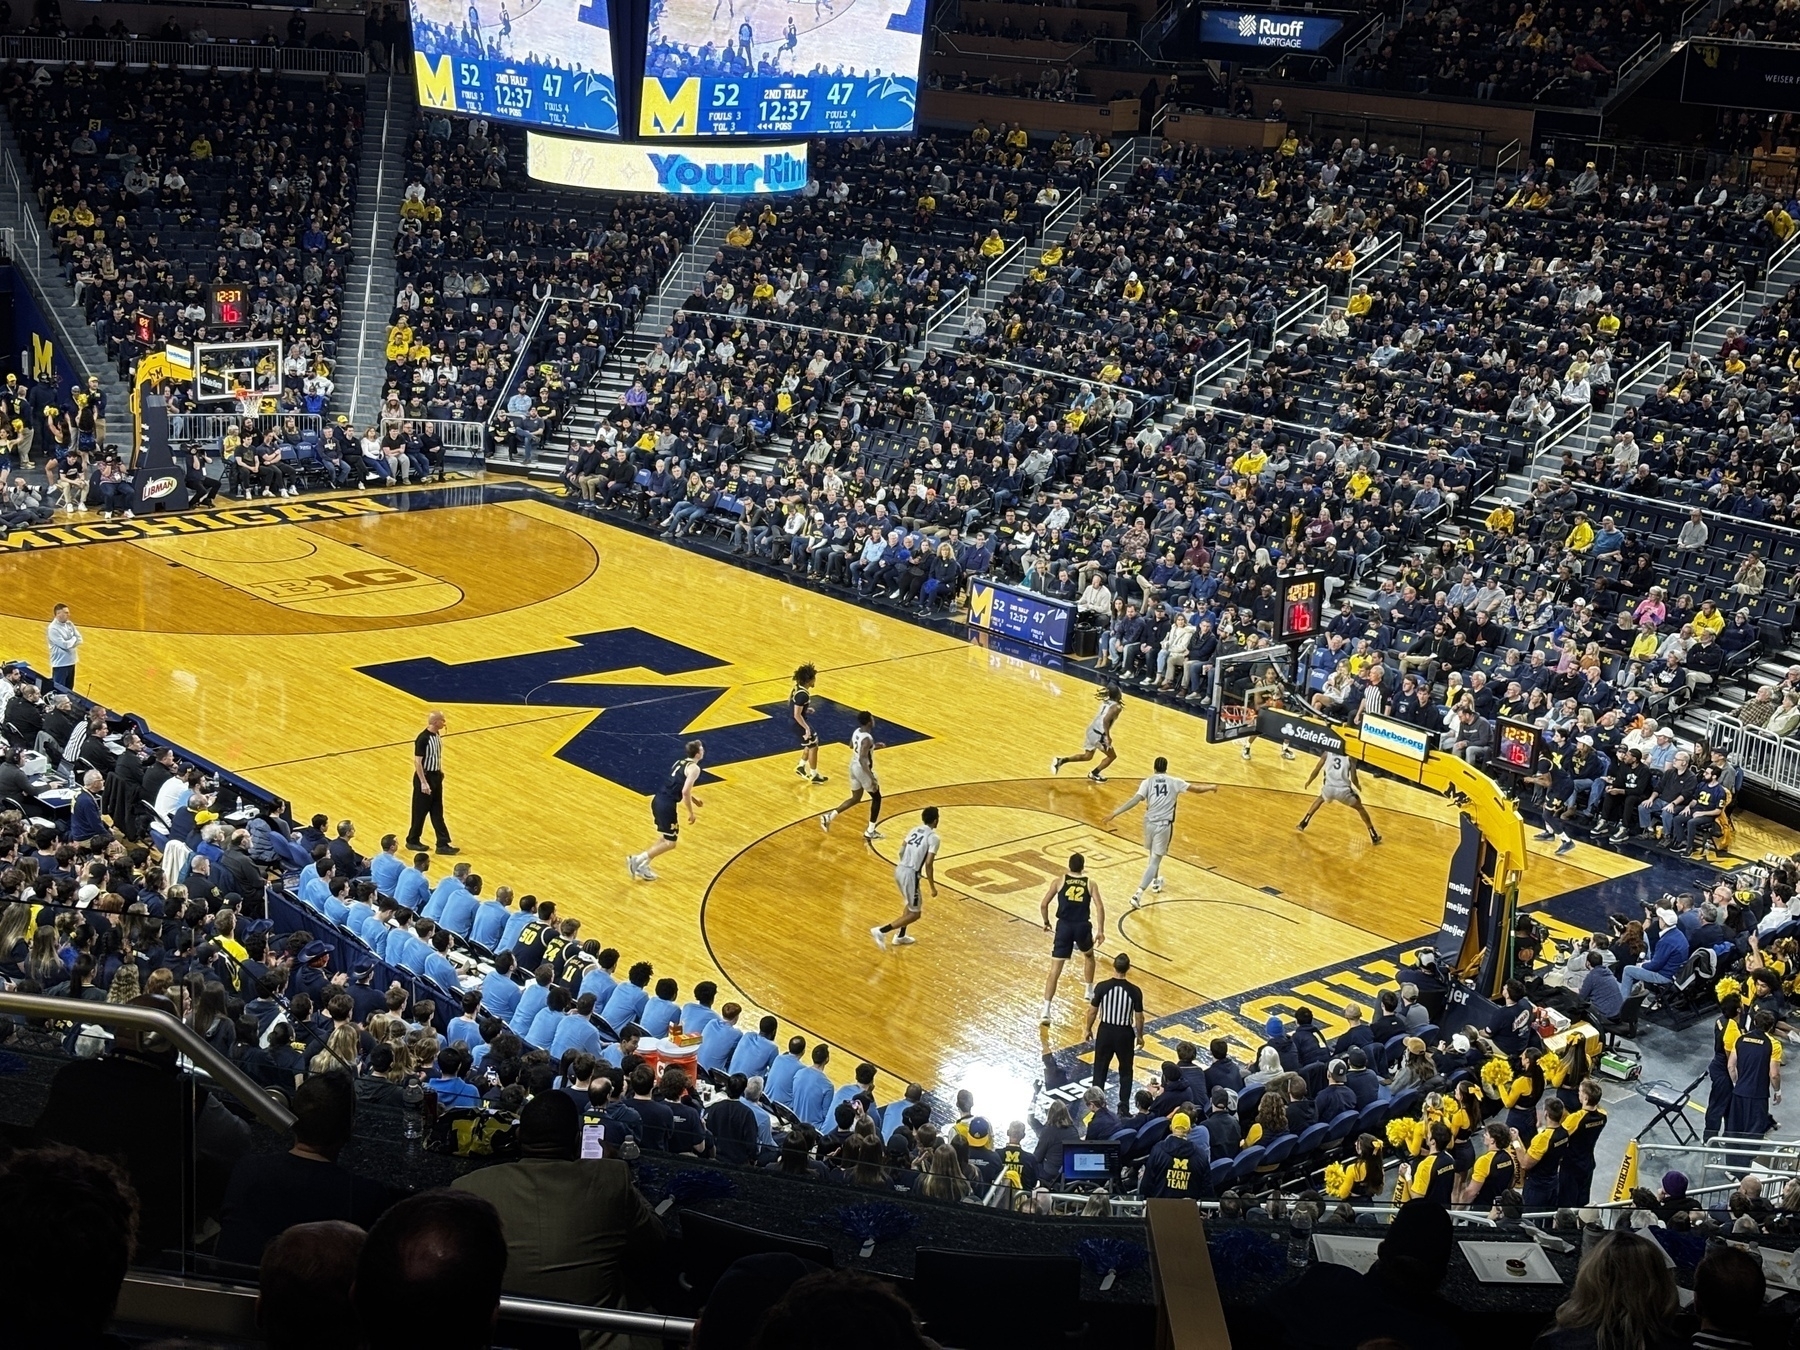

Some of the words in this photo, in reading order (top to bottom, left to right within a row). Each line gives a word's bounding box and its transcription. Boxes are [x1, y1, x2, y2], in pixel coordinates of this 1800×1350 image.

[1259, 18, 1304, 37] Ruoff
[1258, 37, 1302, 48] MORTGAGE
[414, 51, 457, 111] M
[461, 63, 480, 87] 52
[496, 73, 509, 84] 2ND
[510, 75, 528, 87] HALF
[1764, 74, 1794, 84] WEISER
[543, 74, 563, 98] 47
[461, 90, 479, 101] FOULS
[479, 92, 485, 101] 3
[494, 85, 533, 109] 12:37
[711, 83, 740, 107] 52
[764, 89, 782, 99] 2ND
[784, 89, 808, 100] HALF
[826, 83, 854, 105] 47
[477, 102, 482, 111] 3
[544, 101, 563, 112] FOULS
[564, 103, 570, 113] 4
[639, 77, 701, 136] M
[758, 101, 812, 121] 12:37
[825, 110, 849, 119] FOULS
[850, 109, 857, 119] 4
[549, 113, 560, 122] TOL
[562, 114, 567, 123] 2
[708, 112, 733, 121] FOULS
[735, 111, 742, 121] 3
[713, 123, 730, 131] TOL
[730, 123, 736, 131] 3
[774, 122, 792, 131] POSS
[829, 121, 844, 129] TOL
[845, 120, 851, 129] 2
[646, 152, 754, 186] Your
[131, 178, 143, 187] M
[216, 290, 241, 302] 12:37
[223, 304, 238, 323] 16
[32, 332, 53, 382] M
[142, 480, 174, 502] LIBMAN
[0, 497, 400, 552] MICHIGAN
[1287, 582, 1316, 602] 12:37
[969, 583, 995, 629] M
[993, 599, 1006, 612] 52
[1009, 611, 1028, 624] 12:37
[1032, 611, 1046, 624] 47
[1294, 604, 1310, 631] 16
[1363, 722, 1424, 751] AnnArbor.org
[1504, 726, 1535, 746] 12:37
[1511, 745, 1525, 764] 16
[1333, 757, 1341, 770] 3
[1154, 784, 1168, 797] 14
[1697, 791, 1711, 805] 21
[907, 833, 925, 847] 24
[1064, 885, 1085, 903] 42
[1448, 881, 1472, 896] meijer
[1446, 900, 1470, 916] meijer
[518, 928, 538, 946] 50
[1441, 922, 1465, 938] meijer
[562, 965, 577, 983] 11
[1004, 1150, 1021, 1163] M
[1172, 1157, 1189, 1169] M
[1166, 1169, 1192, 1182] EVENT
[1612, 1155, 1633, 1202] MICHIGAN
[1166, 1178, 1189, 1191] TEAM
